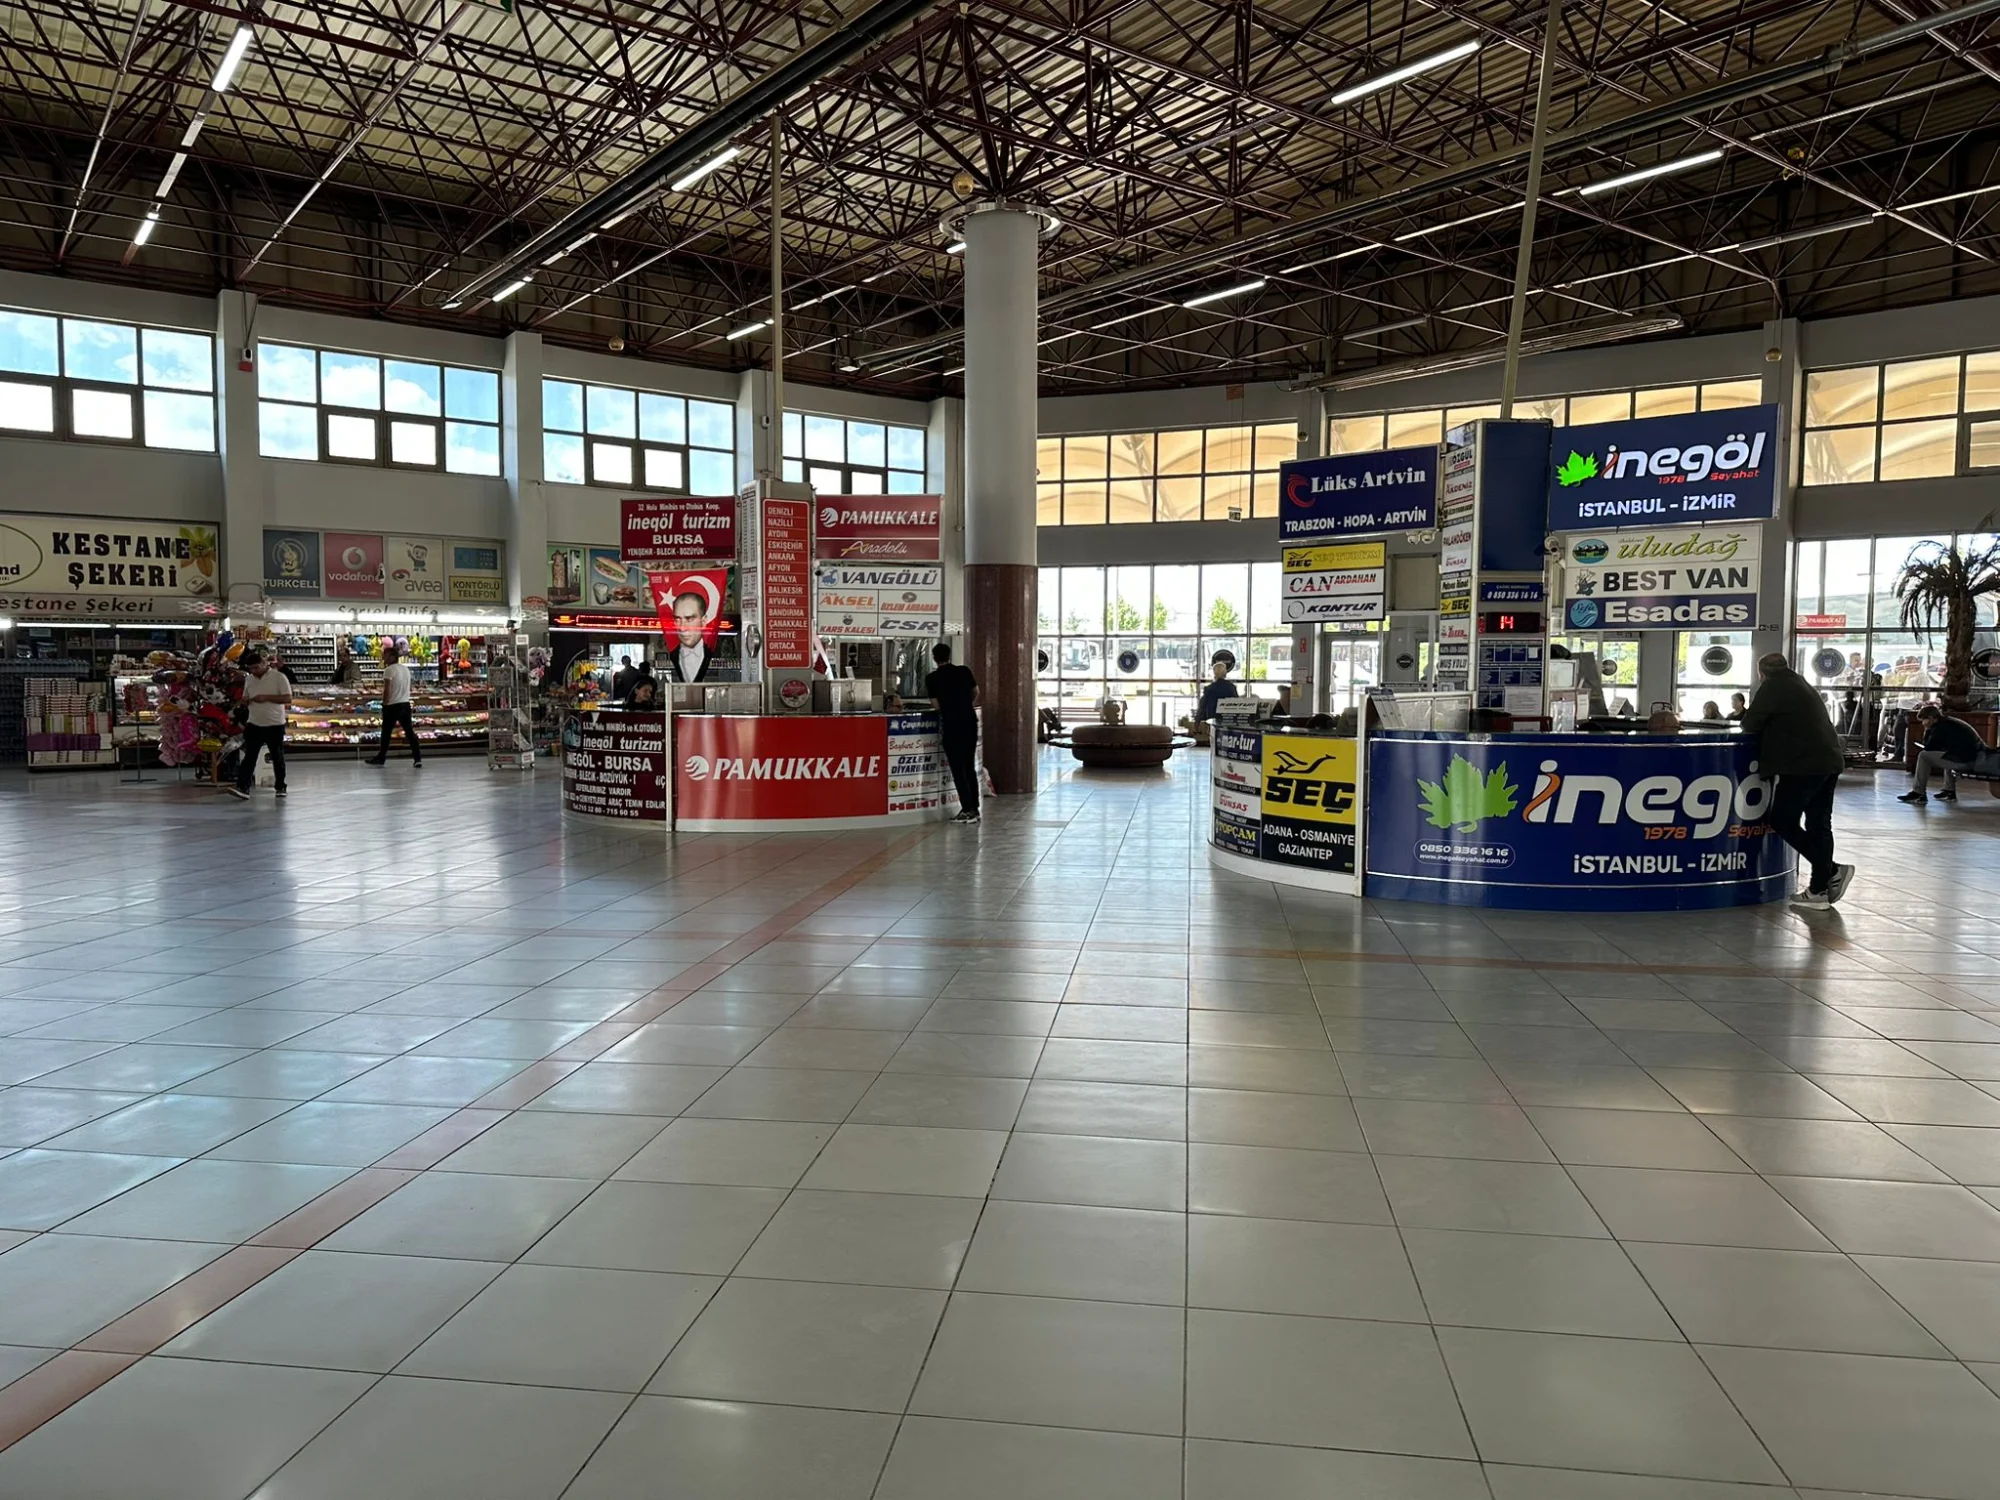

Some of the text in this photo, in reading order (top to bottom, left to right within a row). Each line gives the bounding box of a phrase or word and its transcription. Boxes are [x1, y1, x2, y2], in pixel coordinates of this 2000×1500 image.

[1602, 432, 1766, 482] inegöl
[1310, 466, 1426, 493] Lüks Artvin
[1658, 470, 1759, 485] 1978 Seyahat
[682, 512, 731, 530] turizm
[840, 510, 938, 525] PAMUKKALE
[1285, 517, 1335, 533] TRABZON
[1343, 514, 1375, 528] HOPA
[652, 534, 704, 545] BURSA
[768, 529, 788, 539] AYDIN
[52, 532, 190, 559] KESTANE
[840, 540, 908, 557] Anadolu
[1616, 533, 1748, 562] uludağ
[768, 552, 796, 562] ANKARA
[768, 563, 792, 573] AFYON
[768, 574, 797, 584] ANTALYA
[842, 569, 938, 585] VANGÖLÜ
[1289, 573, 1377, 593] CAN ARDAHAN
[1603, 567, 1749, 592] BEST VAN
[404, 578, 443, 593] avea
[457, 589, 497, 599] TELEFON
[768, 597, 797, 606] AYVALIK
[820, 595, 876, 606] AKSEL
[0, 597, 154, 613] estane Şekeri
[768, 608, 805, 617] BANDIRMA
[1306, 602, 1377, 613] KONTUR
[1604, 599, 1750, 623] Esadaş
[769, 619, 809, 630] ÇANAKKALE
[819, 625, 845, 634] KARS
[879, 619, 939, 631] CSR
[769, 642, 796, 651] ORTACA
[769, 653, 803, 662] DALAMAN
[620, 736, 664, 751] turizm
[604, 755, 653, 772] BURSA
[713, 756, 881, 780] PAMUKKALE
[1264, 775, 1355, 814] SEÇ
[1522, 760, 1774, 840] inegö
[1263, 823, 1293, 839] ADANA
[1643, 825, 1687, 841] 1978
[1419, 842, 1510, 858] 0850 336 16 16
